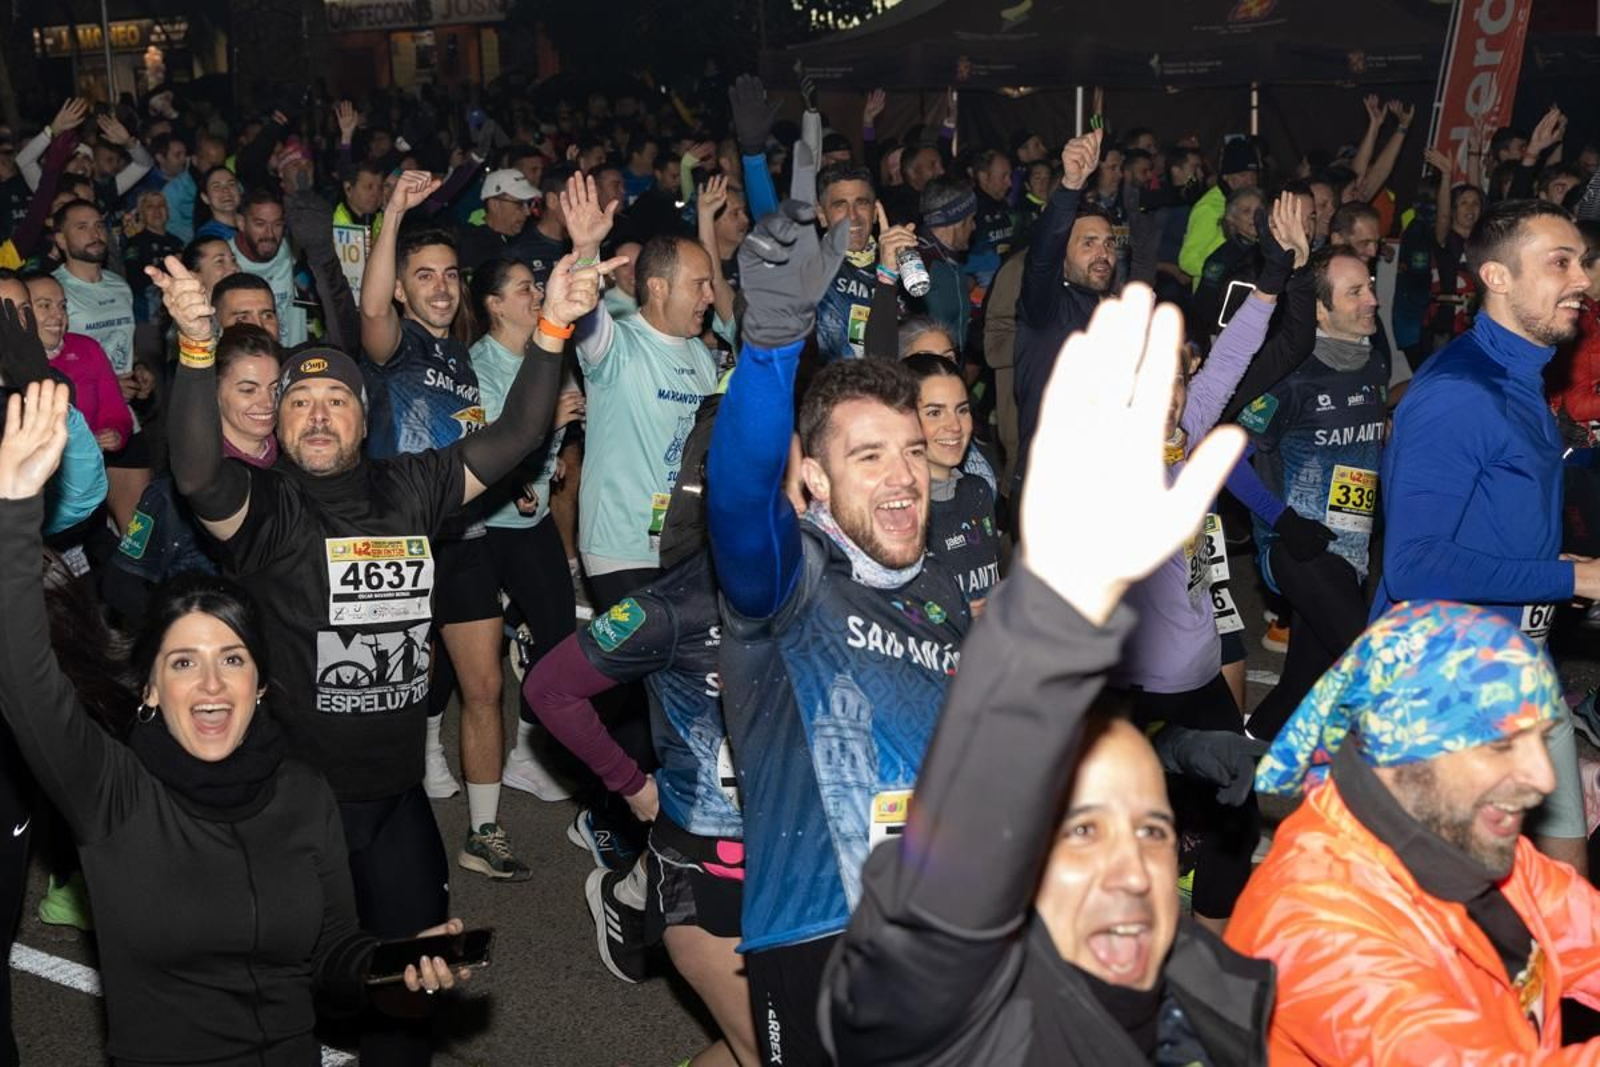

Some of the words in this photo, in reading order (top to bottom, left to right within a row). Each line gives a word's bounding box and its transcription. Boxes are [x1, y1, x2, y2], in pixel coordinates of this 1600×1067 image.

[836, 278, 869, 299] SAN
[424, 367, 455, 393] SAN
[1314, 426, 1355, 446] SAN
[340, 560, 425, 591] 4637
[847, 615, 905, 659] SAN
[316, 689, 411, 713] ESPELUY
